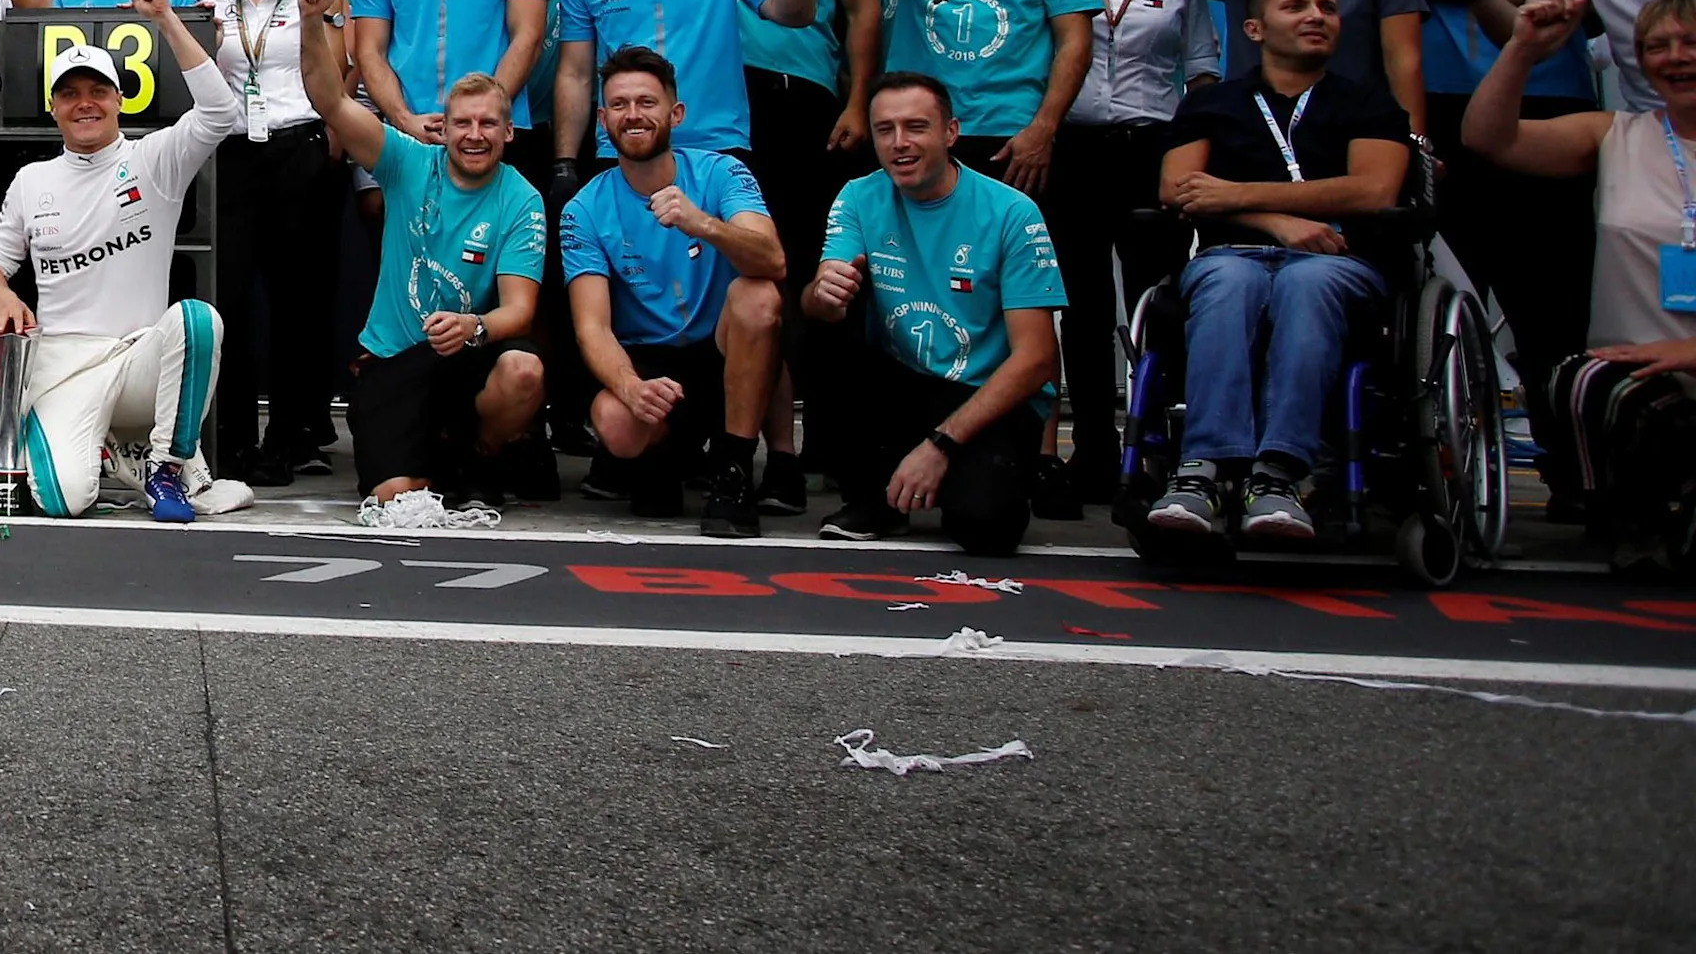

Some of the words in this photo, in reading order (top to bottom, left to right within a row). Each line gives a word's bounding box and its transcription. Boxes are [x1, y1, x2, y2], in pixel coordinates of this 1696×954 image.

[947, 49, 976, 62] 2018
[40, 224, 153, 275] PETRONAS
[882, 265, 906, 280] UBS
[232, 554, 550, 588] 77
